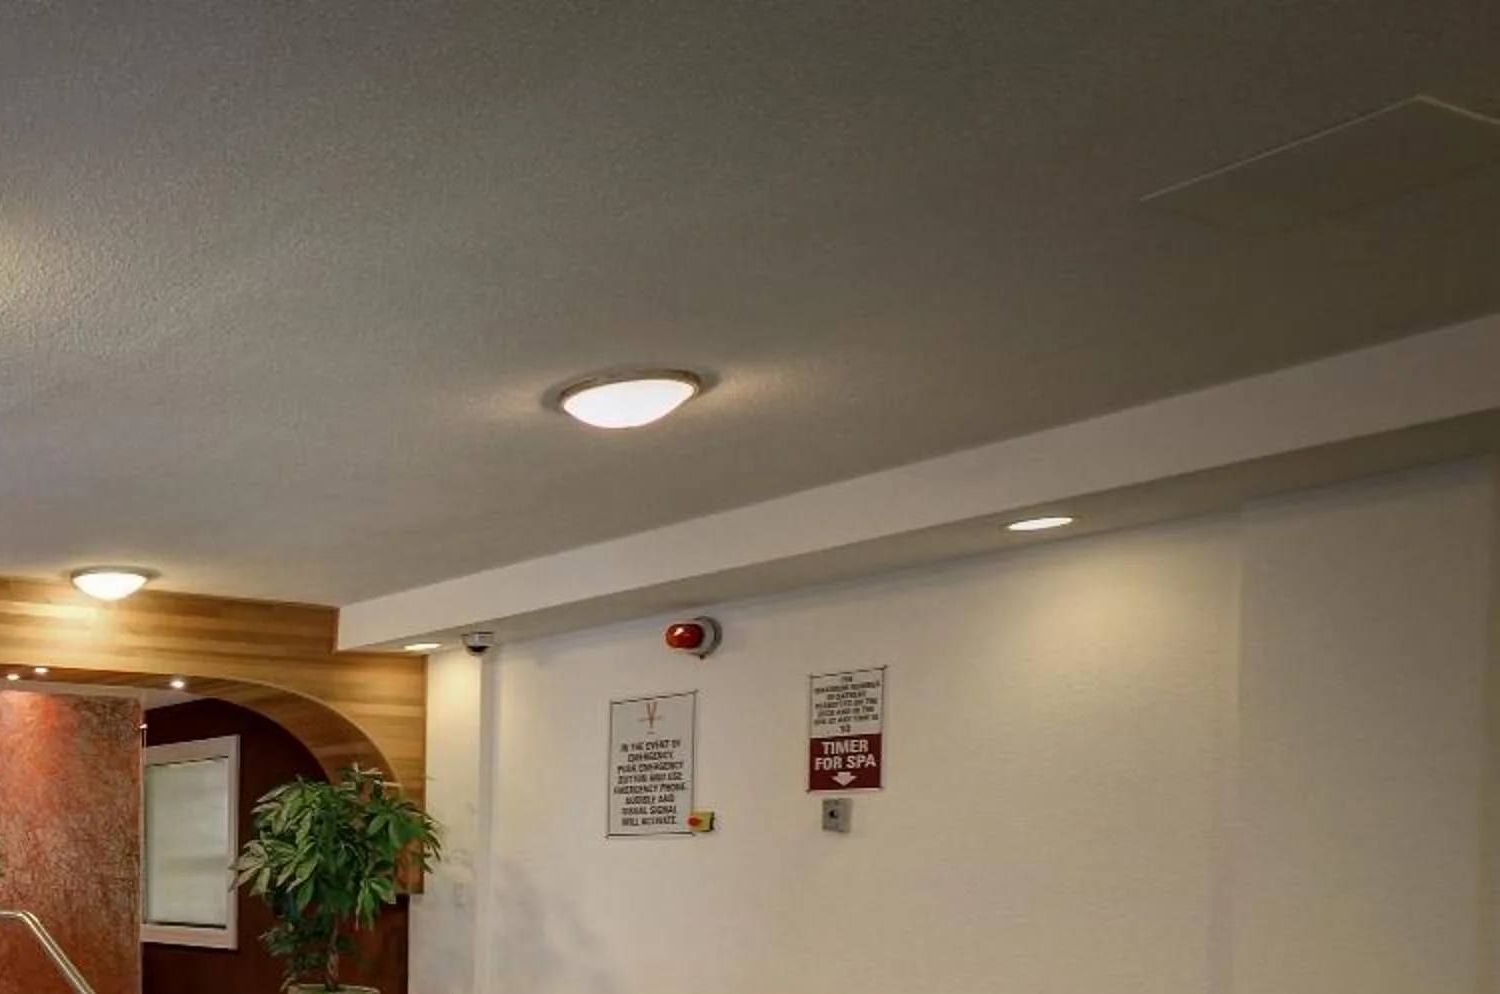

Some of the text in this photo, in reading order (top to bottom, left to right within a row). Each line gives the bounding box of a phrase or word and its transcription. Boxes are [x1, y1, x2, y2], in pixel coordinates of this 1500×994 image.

[821, 740, 869, 754] TIMER
[815, 754, 876, 771] FOR SPA
